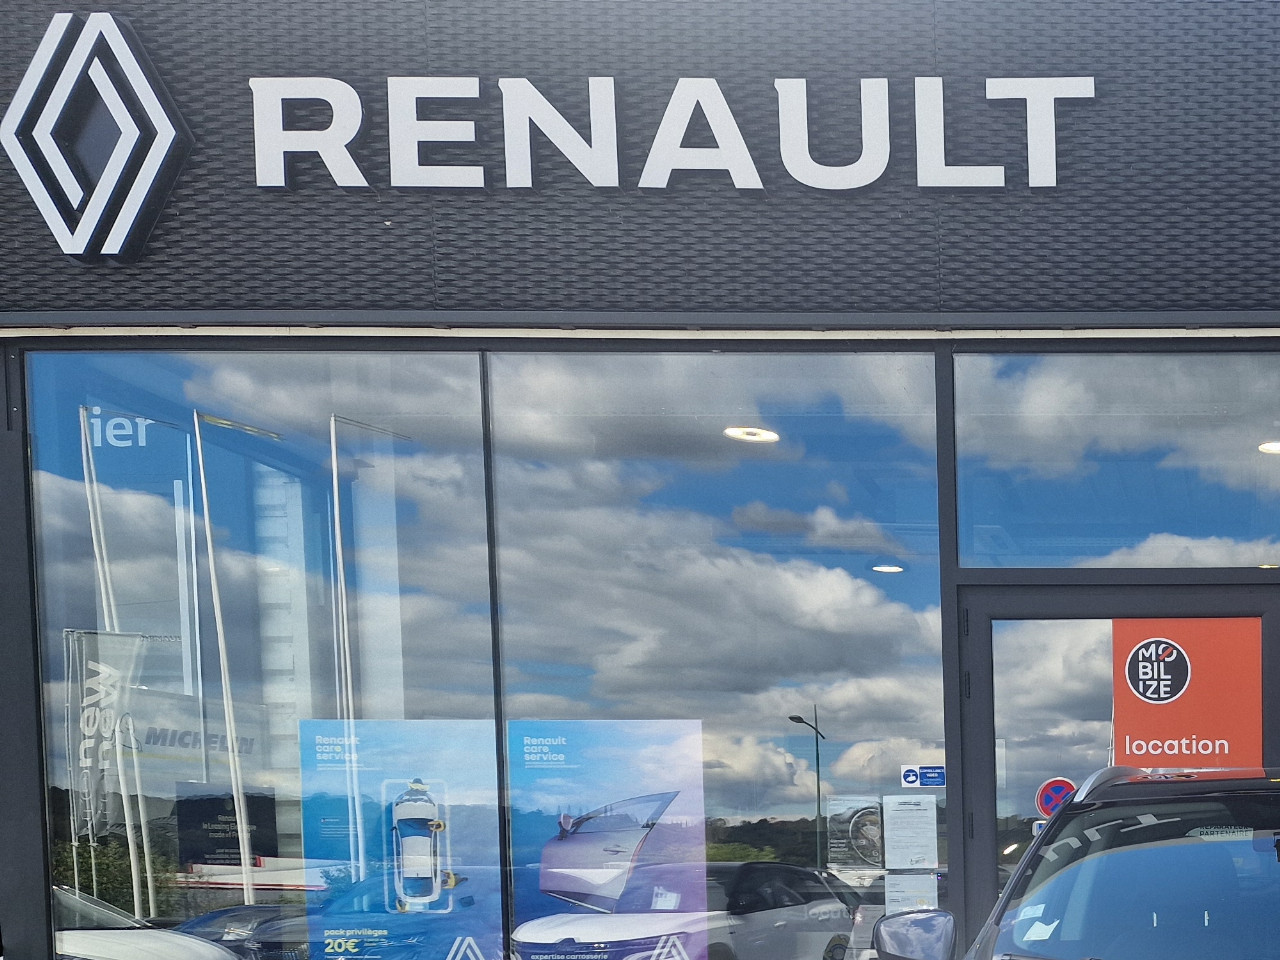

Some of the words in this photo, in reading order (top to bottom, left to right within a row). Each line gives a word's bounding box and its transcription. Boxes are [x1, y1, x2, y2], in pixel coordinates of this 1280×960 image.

[249, 76, 1095, 190] RENAULT
[523, 736, 568, 745] Renault
[1125, 735, 1229, 755] location
[523, 745, 550, 753] care
[524, 752, 566, 761] service
